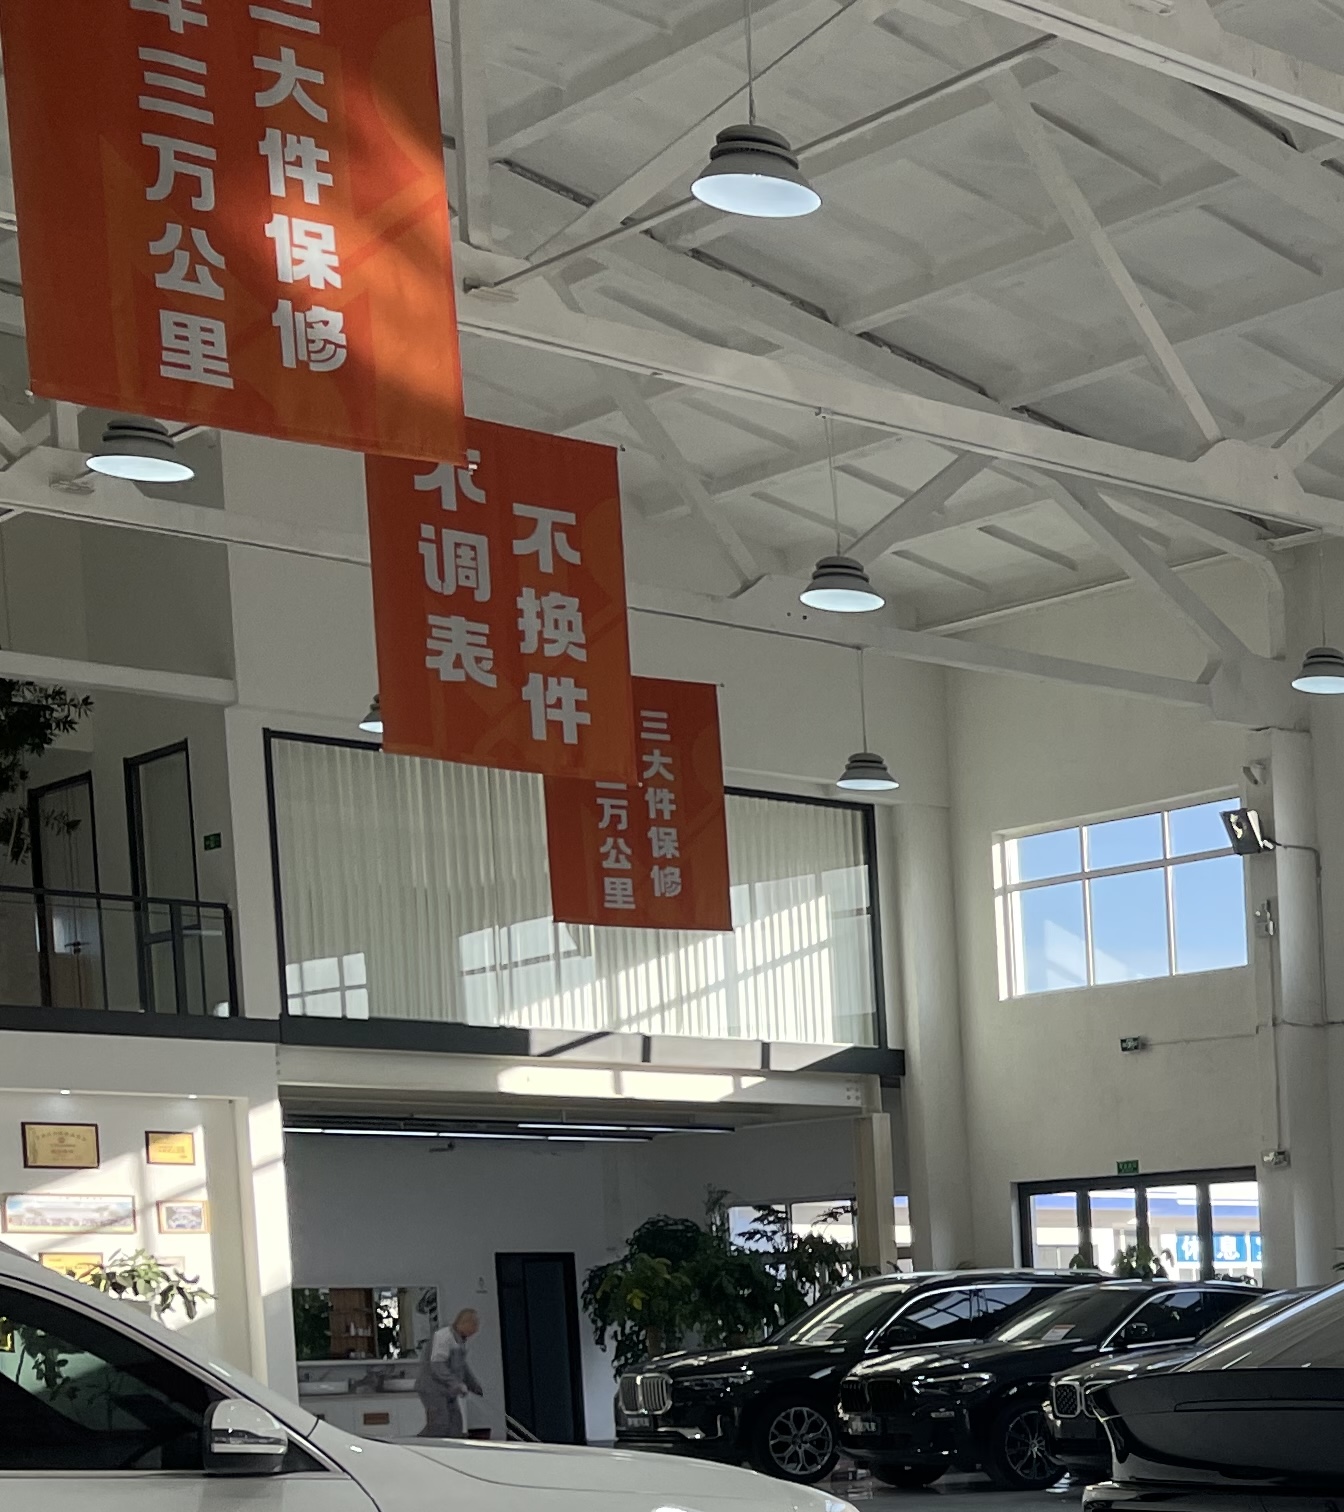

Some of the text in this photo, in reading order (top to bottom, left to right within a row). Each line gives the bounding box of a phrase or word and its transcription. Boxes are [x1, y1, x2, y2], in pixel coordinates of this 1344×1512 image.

[512, 502, 591, 745] 不换件
[640, 709, 682, 897] 三大件保修
